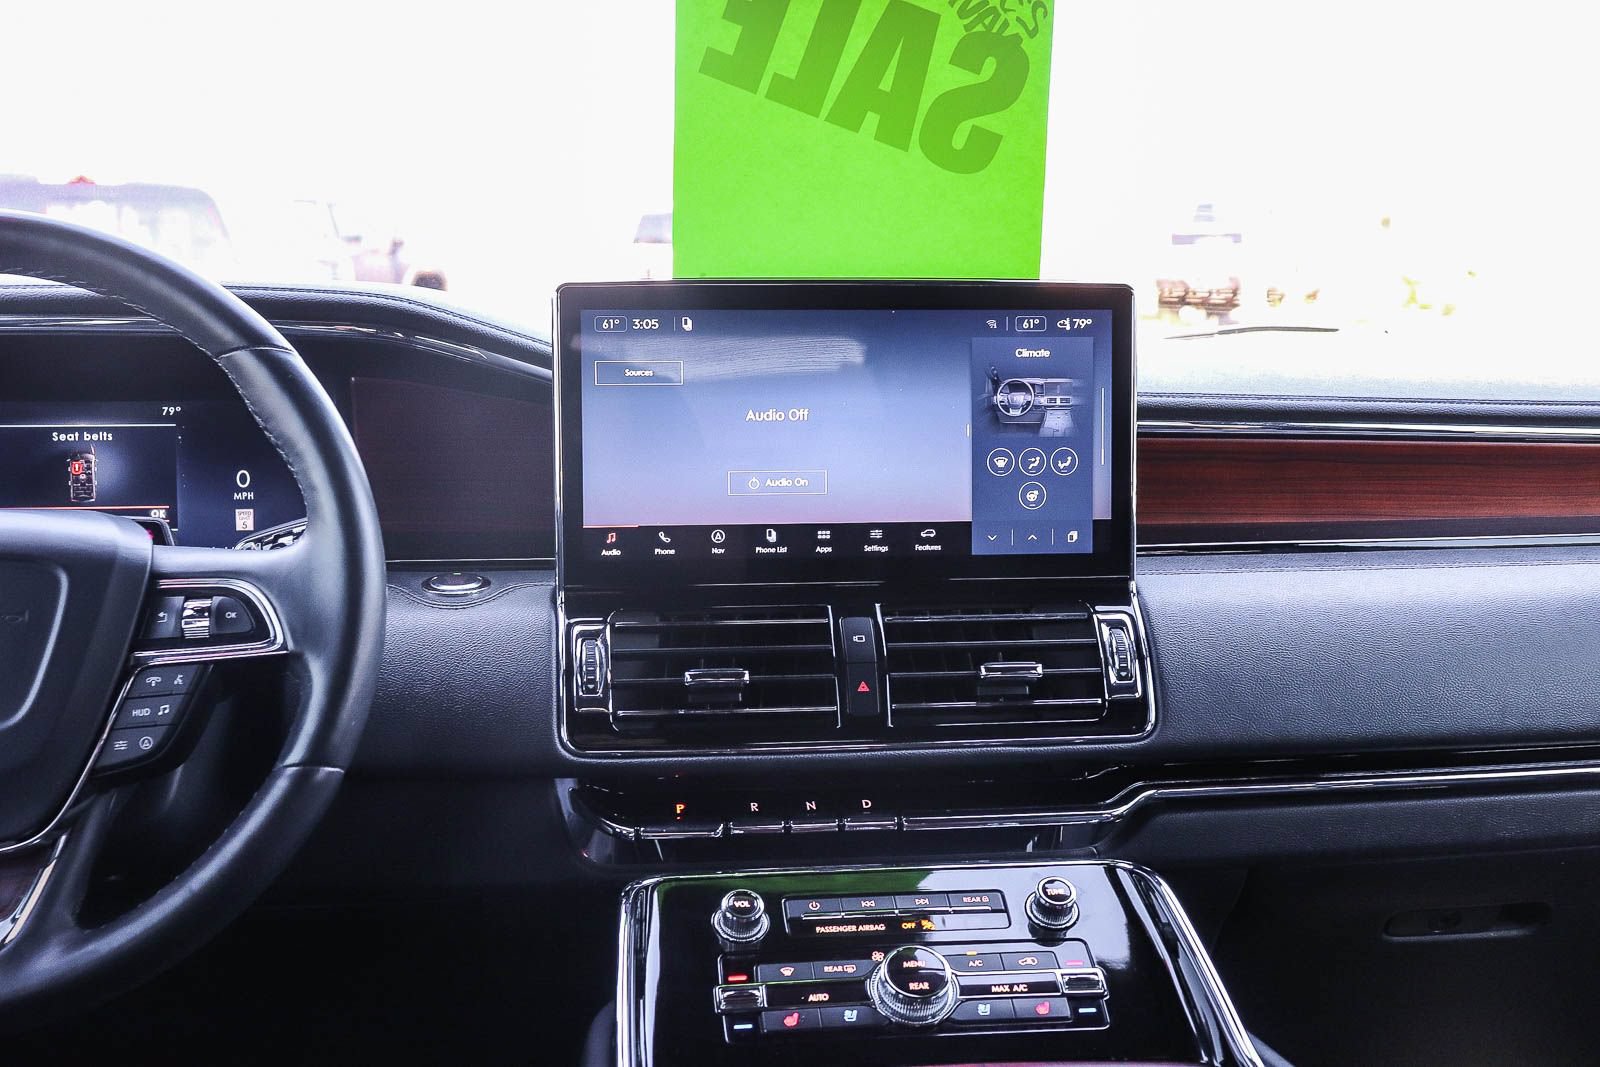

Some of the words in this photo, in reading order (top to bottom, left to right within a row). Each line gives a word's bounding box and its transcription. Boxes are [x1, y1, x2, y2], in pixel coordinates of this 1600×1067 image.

[632, 319, 660, 330] 3:05
[1015, 348, 1051, 358] Climate
[624, 368, 654, 378] Sources
[745, 409, 785, 422] Audio
[788, 408, 809, 421] Off
[52, 431, 79, 442] Seat
[83, 430, 113, 442] belts
[765, 477, 793, 488] Audio
[795, 477, 809, 487] On
[233, 491, 255, 501] MPH
[150, 508, 167, 519] OK
[241, 520, 248, 530] 5
[601, 548, 621, 557] Audio
[654, 547, 676, 556] Phone
[711, 547, 726, 555] Nav
[755, 546, 775, 555] Phone
[776, 546, 788, 554] List
[815, 545, 833, 555] Apps
[863, 544, 889, 553] Settings
[914, 543, 942, 552] Features
[225, 611, 237, 619] OK
[131, 707, 151, 718] HUD
[675, 803, 685, 814] P
[750, 802, 759, 812] R
[806, 801, 817, 811] N
[862, 799, 872, 809] D
[734, 900, 751, 909] VOL
[815, 924, 857, 934] PASSENGER
[857, 923, 886, 933] AIRBAG
[901, 921, 916, 930] OFF
[823, 964, 844, 973] REAR
[902, 960, 927, 969] MENU
[968, 959, 983, 969] A/C
[908, 981, 930, 991] REAR
[991, 984, 1010, 994] MAX
[1012, 983, 1029, 993] A/C
[808, 992, 830, 1003] AUTO
